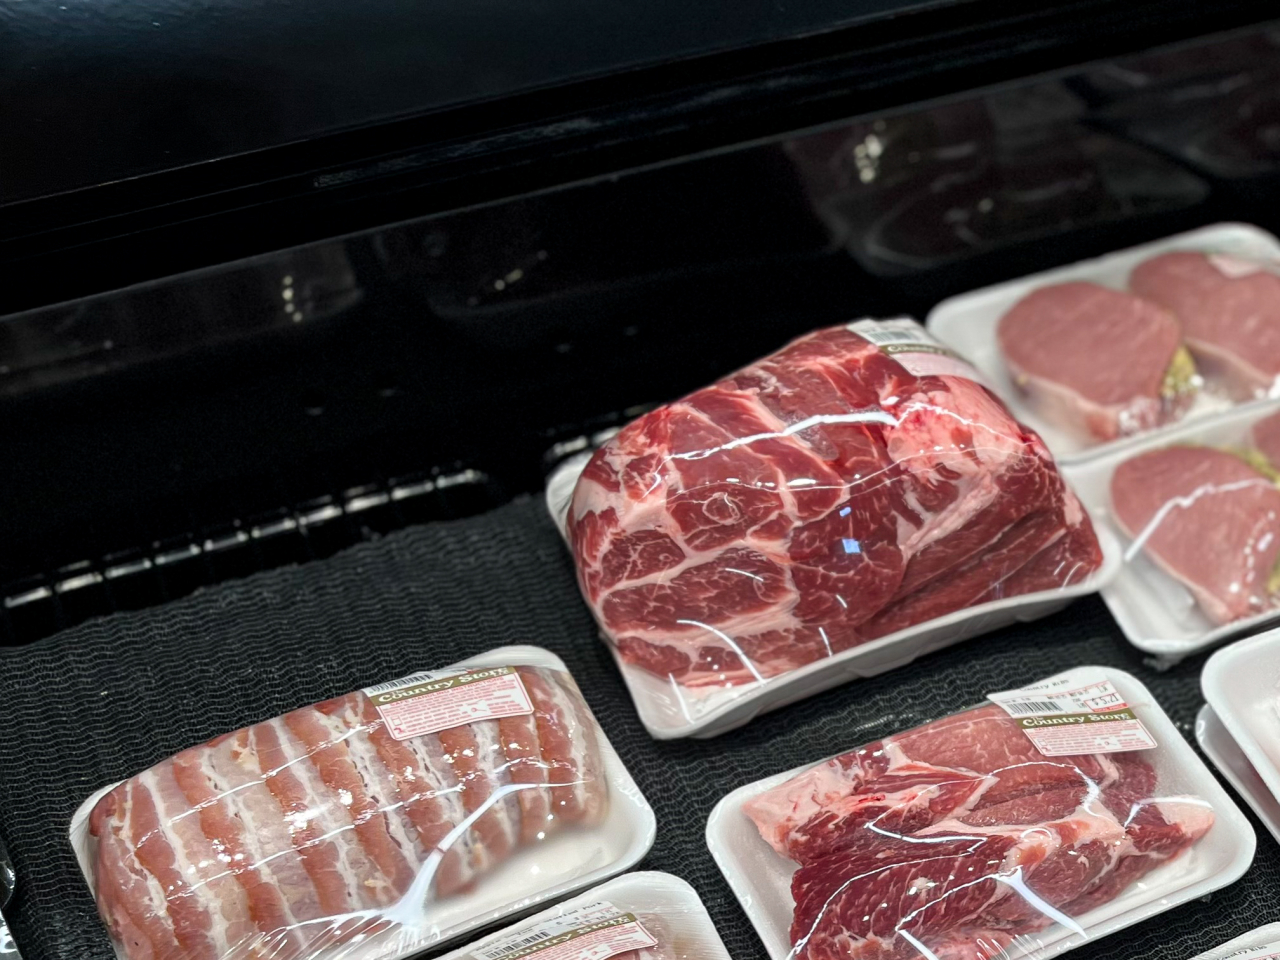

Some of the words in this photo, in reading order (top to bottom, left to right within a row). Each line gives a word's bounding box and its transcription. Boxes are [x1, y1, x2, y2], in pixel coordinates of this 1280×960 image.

[378, 680, 454, 702] Country
[458, 667, 509, 683] Store
[1100, 692, 1120, 705] 5.21
[1022, 715, 1085, 727] Country
[1088, 712, 1130, 721] Store
